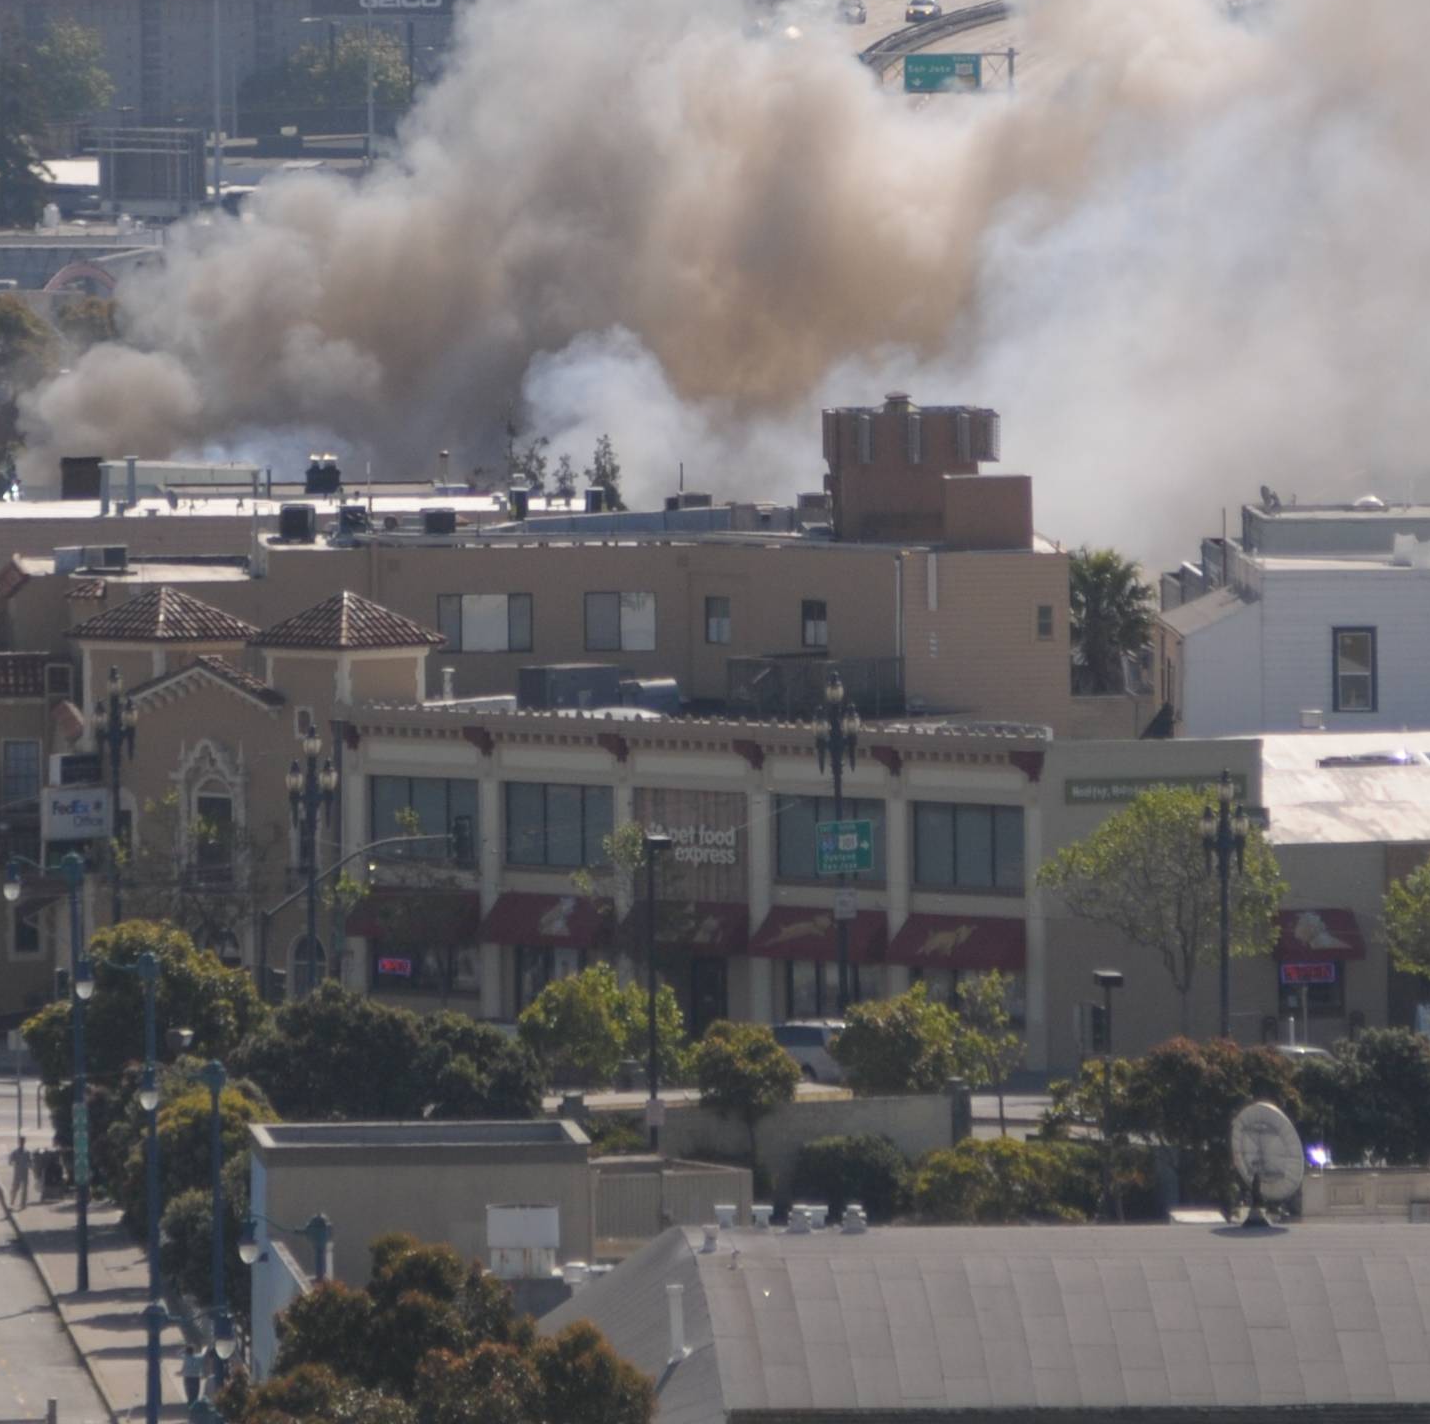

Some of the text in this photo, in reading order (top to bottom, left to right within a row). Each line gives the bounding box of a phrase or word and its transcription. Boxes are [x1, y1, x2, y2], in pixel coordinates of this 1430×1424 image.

[52, 800, 92, 815] FedEx
[668, 823, 736, 846] pet food
[675, 846, 736, 868] express
